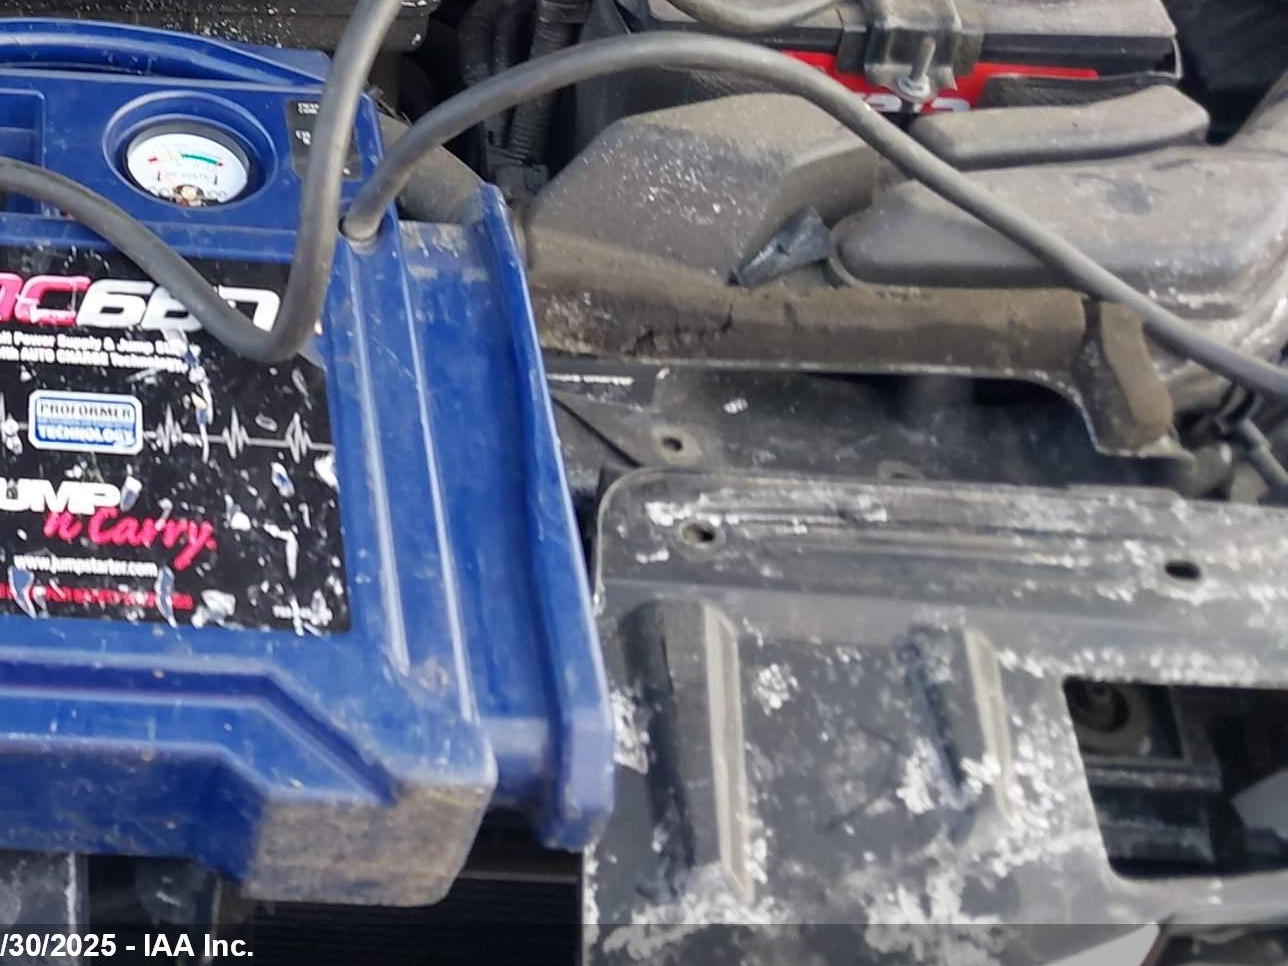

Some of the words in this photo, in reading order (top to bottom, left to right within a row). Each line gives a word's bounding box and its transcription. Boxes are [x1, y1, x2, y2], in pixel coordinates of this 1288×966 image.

[14, 331, 56, 349] Power
[57, 334, 103, 353] Supply
[104, 337, 116, 351] &
[117, 338, 155, 356] Jump
[20, 347, 55, 364] AUTO
[40, 402, 131, 418] PROFORMER
[37, 423, 134, 446] TECHNOLOGY
[12, 553, 159, 577] www.jumpstarter.com
